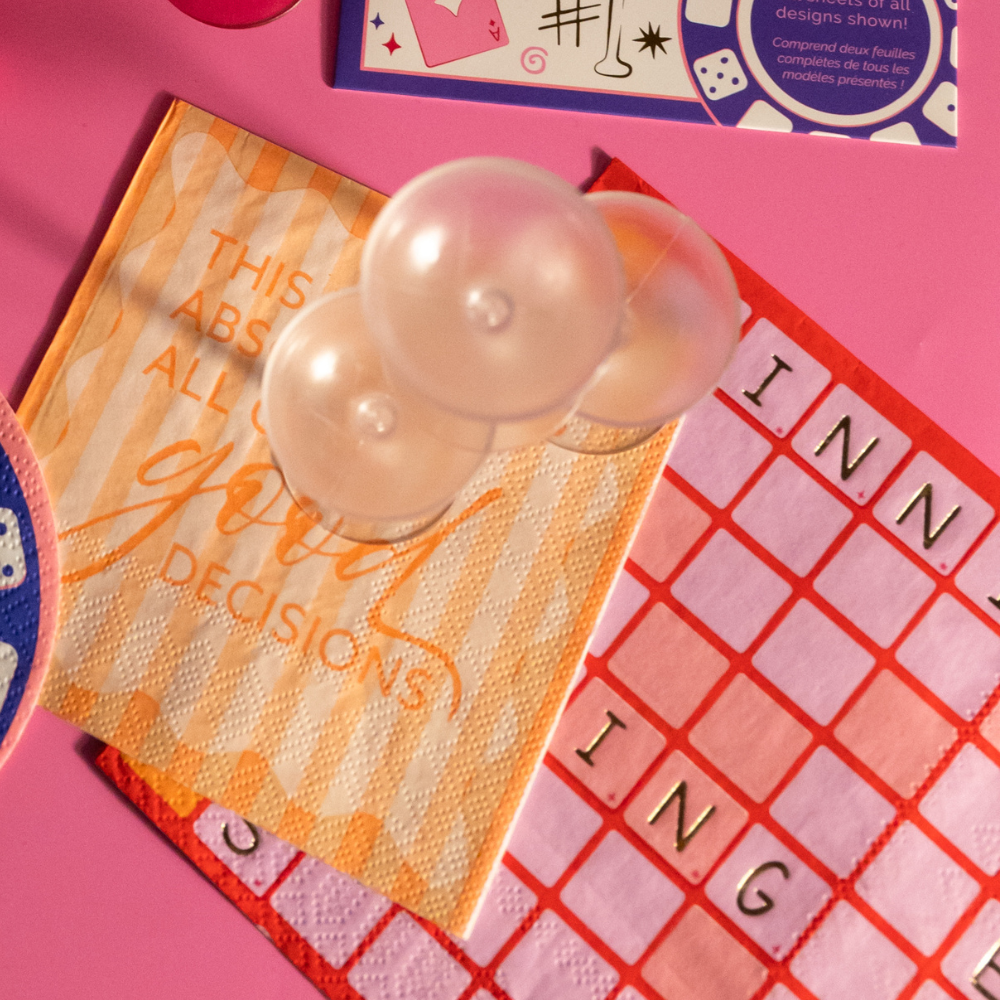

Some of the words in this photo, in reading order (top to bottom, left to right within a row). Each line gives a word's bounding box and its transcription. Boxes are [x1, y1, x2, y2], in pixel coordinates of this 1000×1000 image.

[772, 36, 838, 52] Comprend
[839, 43, 870, 55] deux
[871, 45, 916, 60] feuilles
[775, 6, 842, 25] designs
[847, 13, 908, 30] shown!
[844, 59, 860, 70] de
[862, 60, 890, 73] tous
[892, 63, 910, 75] les
[207, 228, 314, 310] THIS
[169, 288, 277, 358] ABS
[142, 344, 230, 416] ALL
[158, 542, 433, 711] DECISIONS
